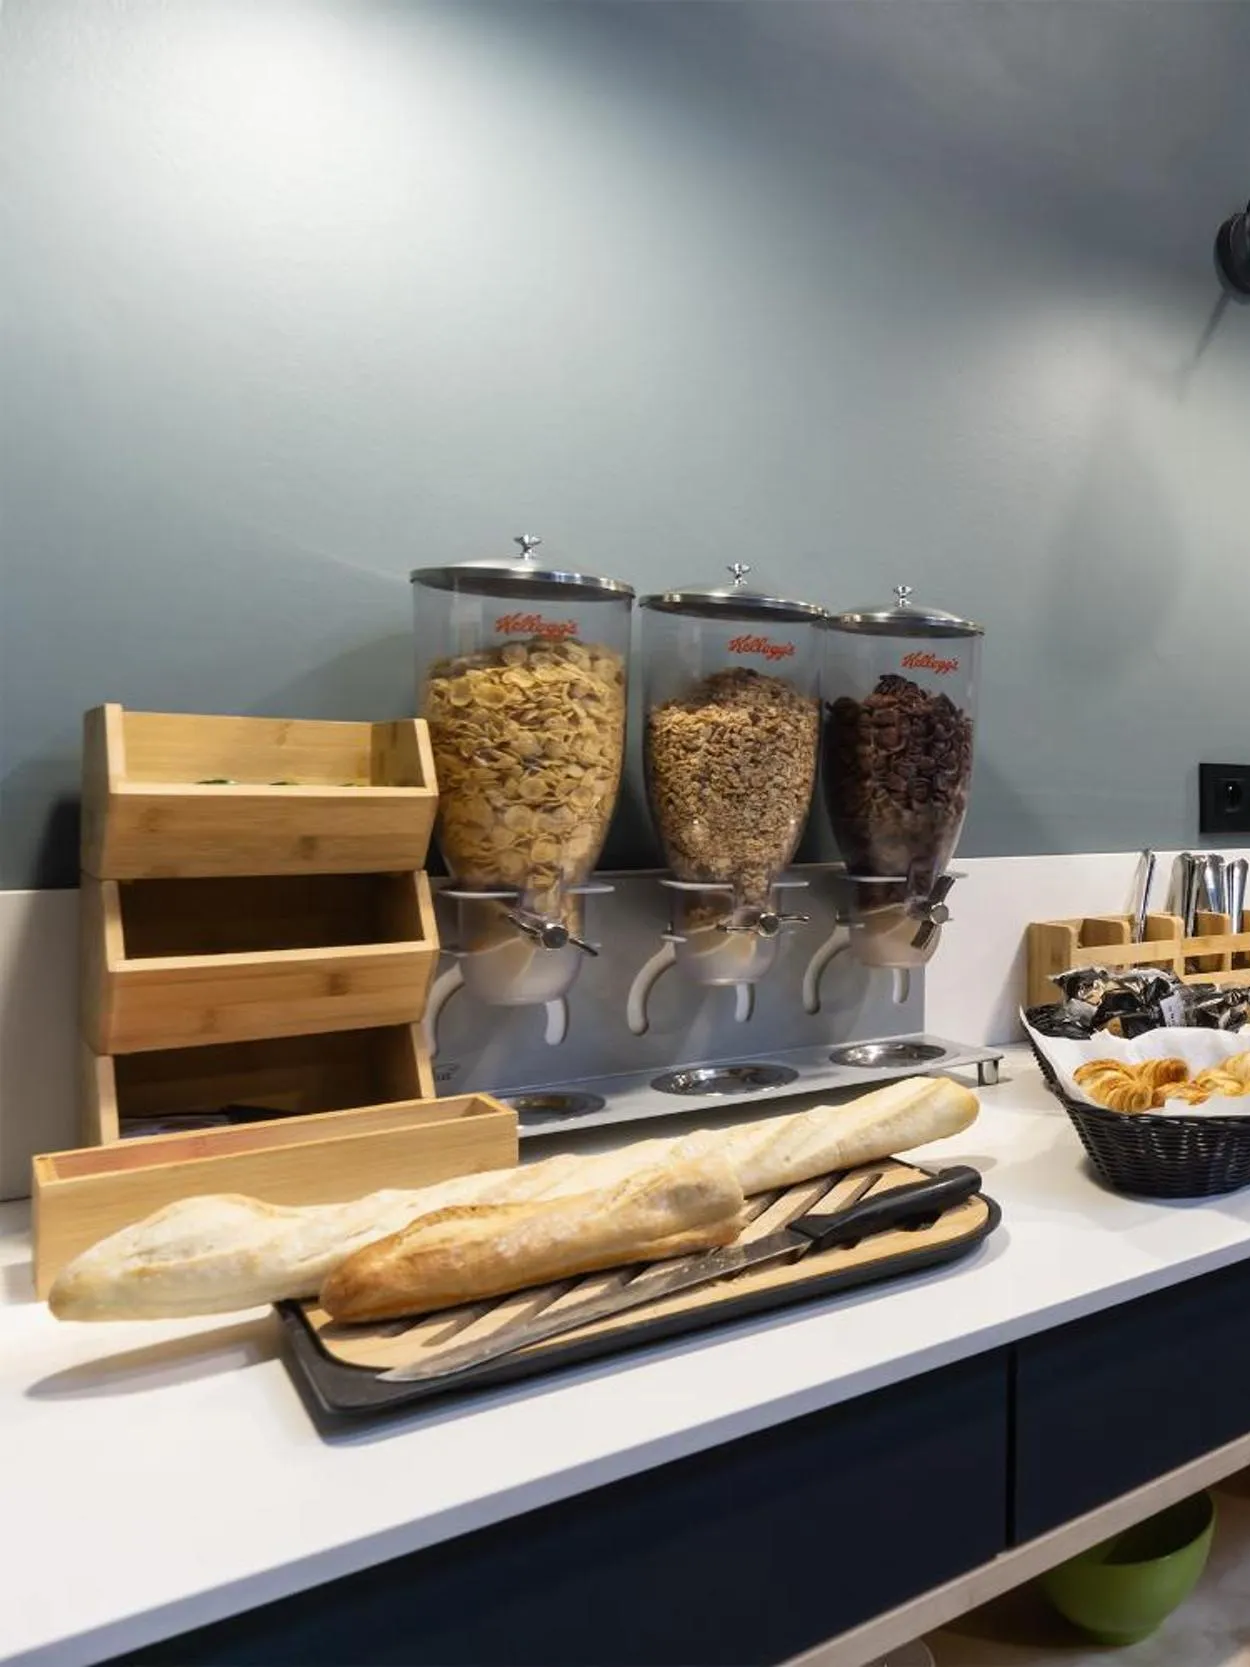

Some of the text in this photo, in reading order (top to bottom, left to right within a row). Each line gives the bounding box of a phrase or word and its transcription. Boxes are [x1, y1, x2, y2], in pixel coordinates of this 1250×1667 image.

[495, 612, 578, 640] Kellogg's
[727, 634, 795, 660] Kellogg's
[901, 651, 959, 674] Kellogg's
